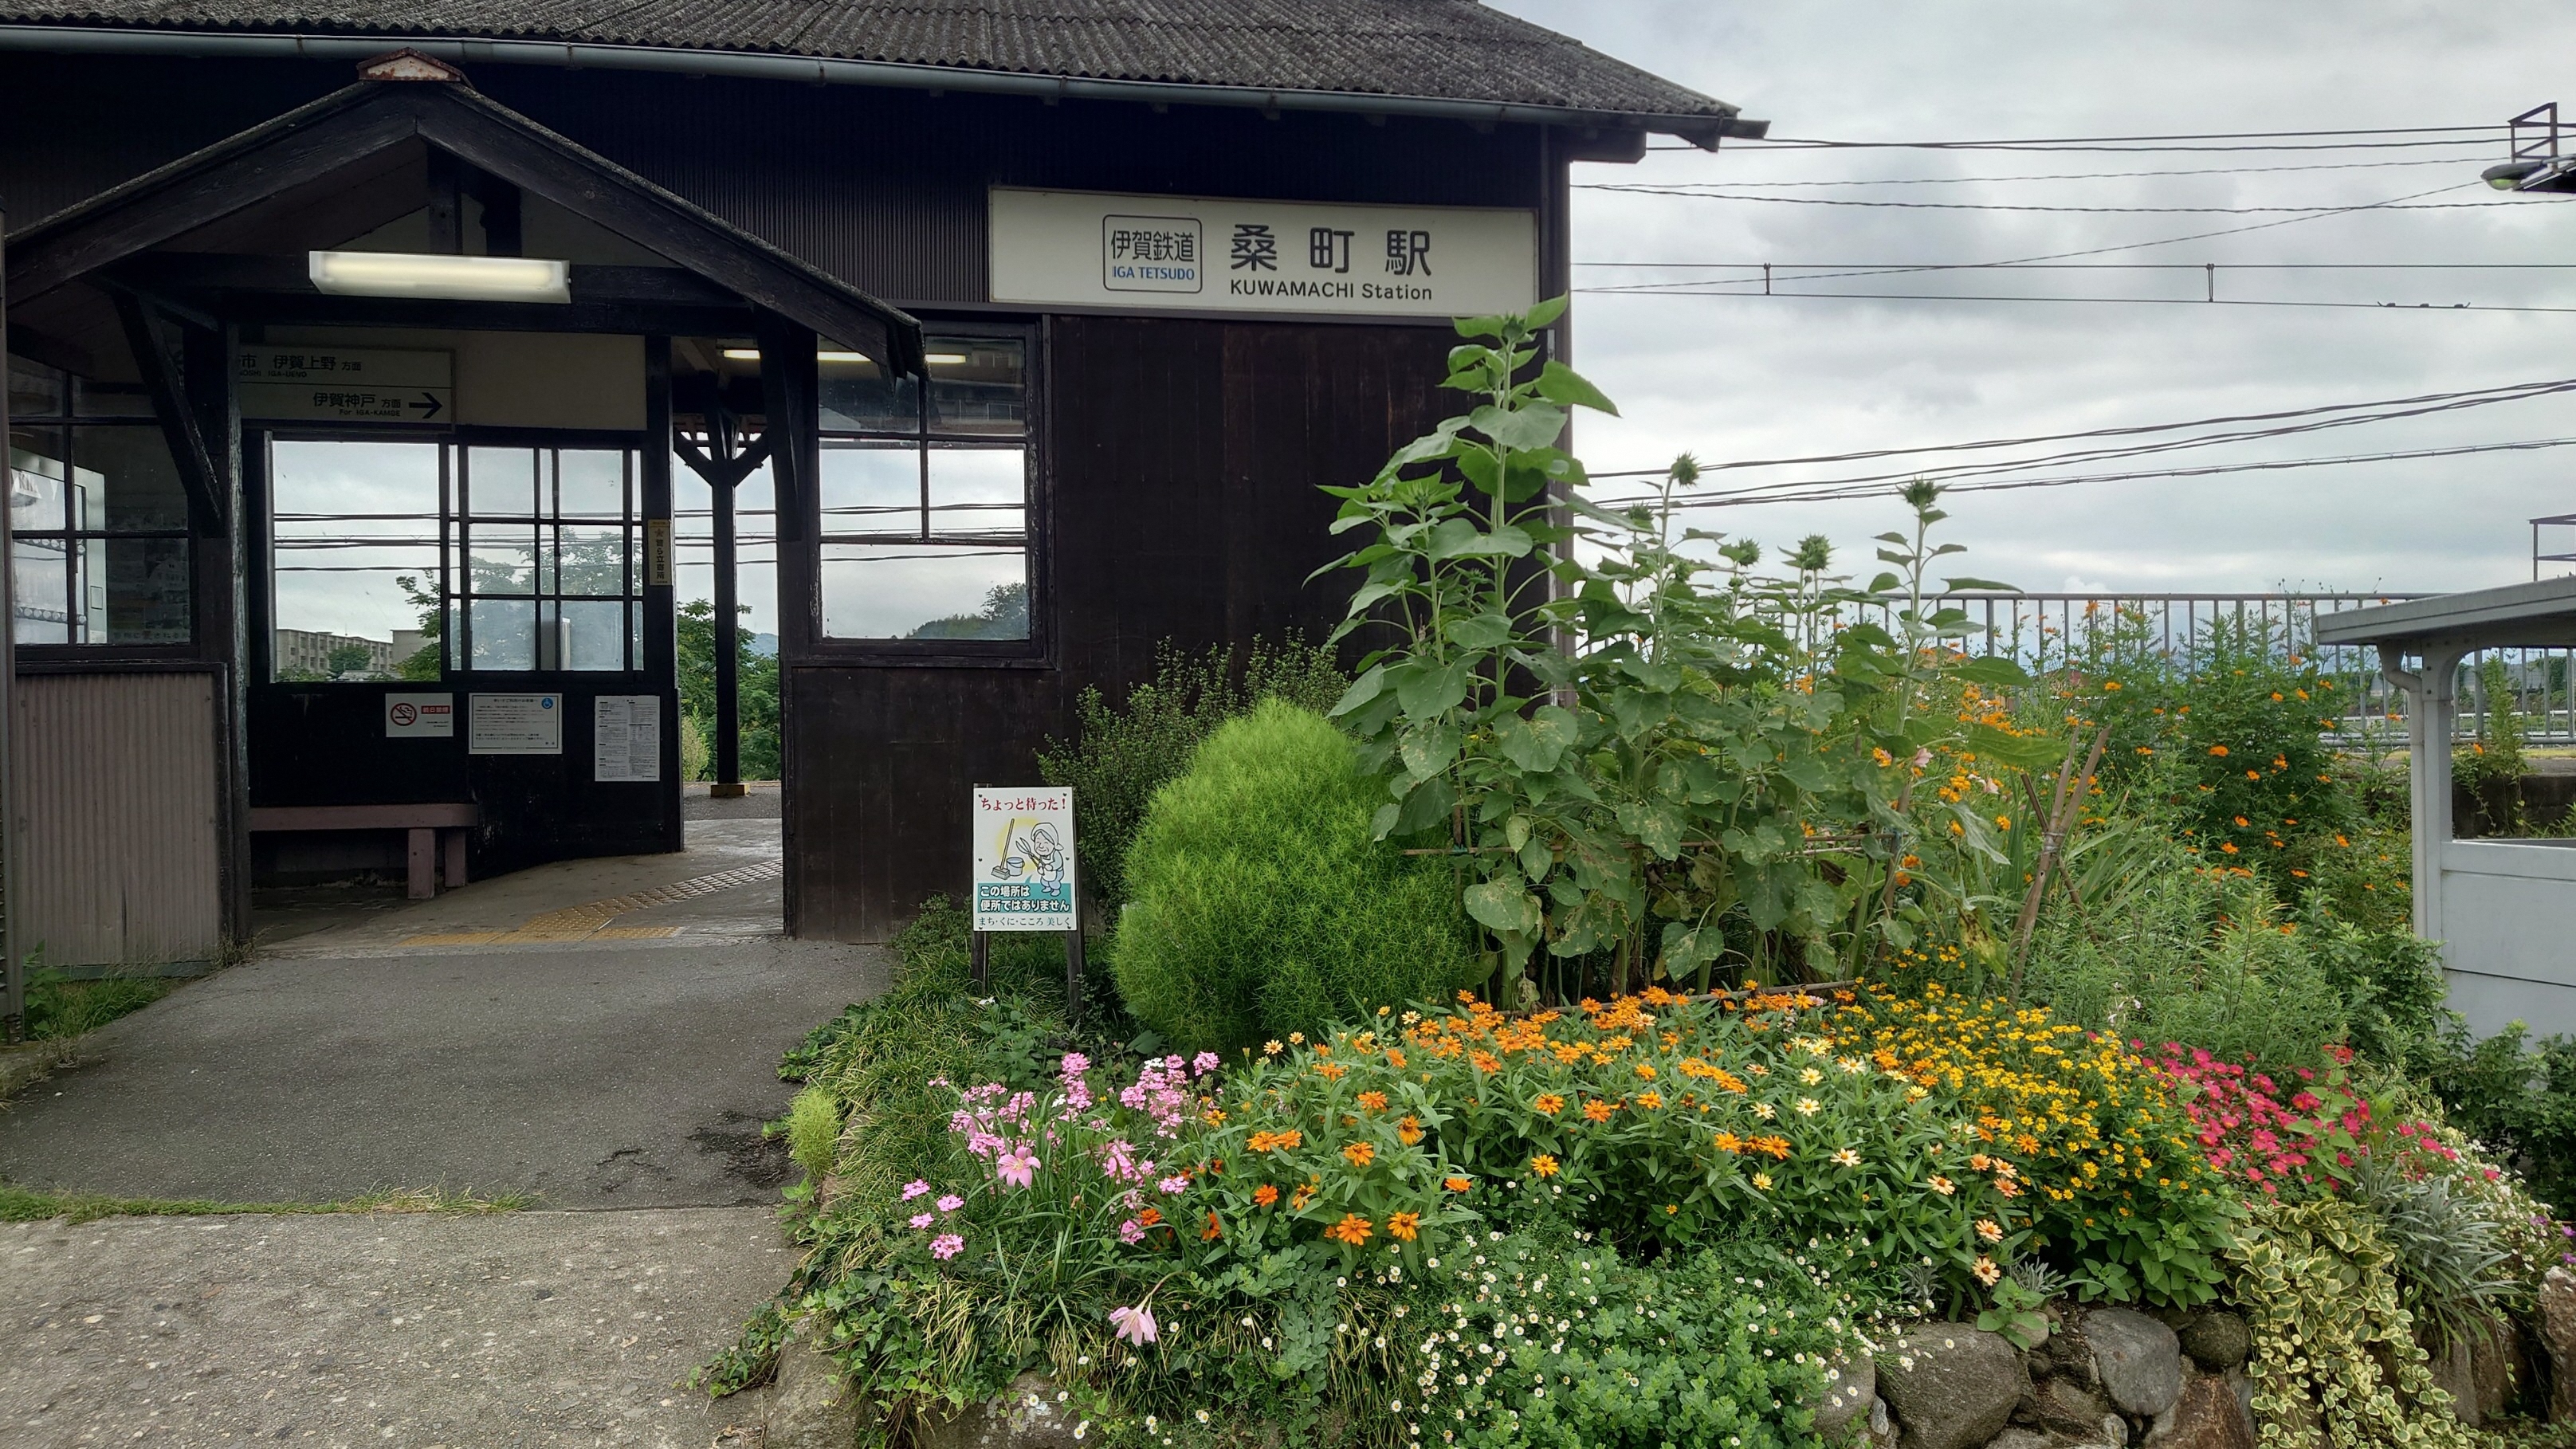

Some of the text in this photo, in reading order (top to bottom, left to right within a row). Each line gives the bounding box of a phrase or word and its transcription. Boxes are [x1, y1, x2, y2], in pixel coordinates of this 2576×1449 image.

[1110, 230, 1195, 262] 伊賀鉄道
[1231, 224, 1432, 276] 桑町駅
[1112, 265, 1195, 281] IGA TETSUDO
[1231, 279, 1432, 300] KUWAMACHI Station
[240, 353, 362, 371] 市 伊賀上野 方面
[312, 392, 402, 408] 伊賀神戸 方面
[980, 797, 1066, 811] ちょっと待った！
[980, 885, 1031, 897] この場所は
[980, 899, 1070, 912] 便所ではありません
